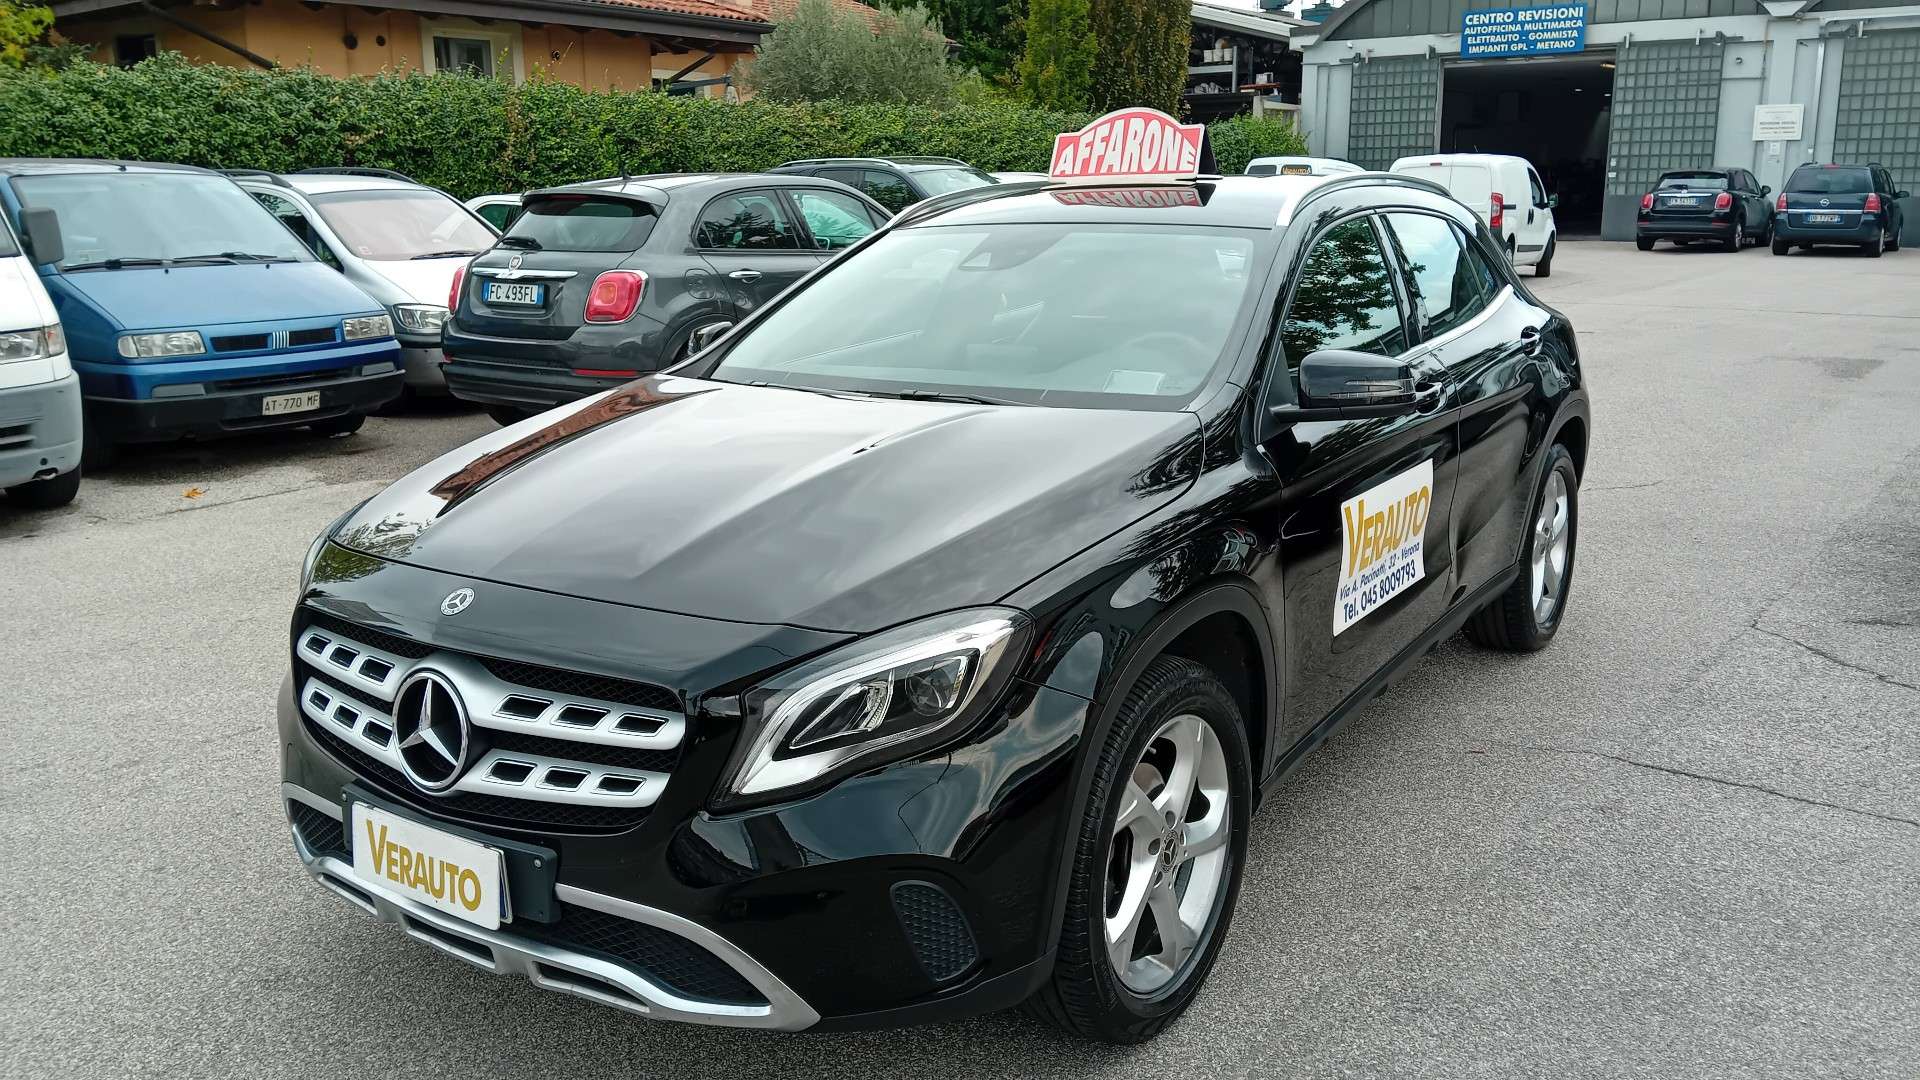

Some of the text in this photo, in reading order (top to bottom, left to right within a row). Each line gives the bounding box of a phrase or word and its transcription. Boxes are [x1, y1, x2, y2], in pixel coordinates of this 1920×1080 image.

[1465, 7, 1584, 25] CENTRO REVISIONI
[1464, 20, 1583, 35] AUTOFFICINA MULTIMARCA
[1467, 34, 1520, 44] ELETTRAUTO
[1528, 30, 1579, 40] GOMMISTA
[1468, 44, 1508, 54] IMPIANTI
[1510, 43, 1528, 52] GPL
[1536, 40, 1576, 50] METANO
[1053, 117, 1197, 176] AFFARONE
[489, 284, 536, 303] FC 493FL
[306, 394, 319, 407] MF
[1344, 485, 1431, 578] VERAUTO
[1340, 586, 1351, 601] Via
[1352, 579, 1359, 593] A.
[1401, 541, 1420, 561] Verona
[1343, 559, 1416, 623] Tel. 045 8009793
[366, 818, 482, 911] VERAUTO
